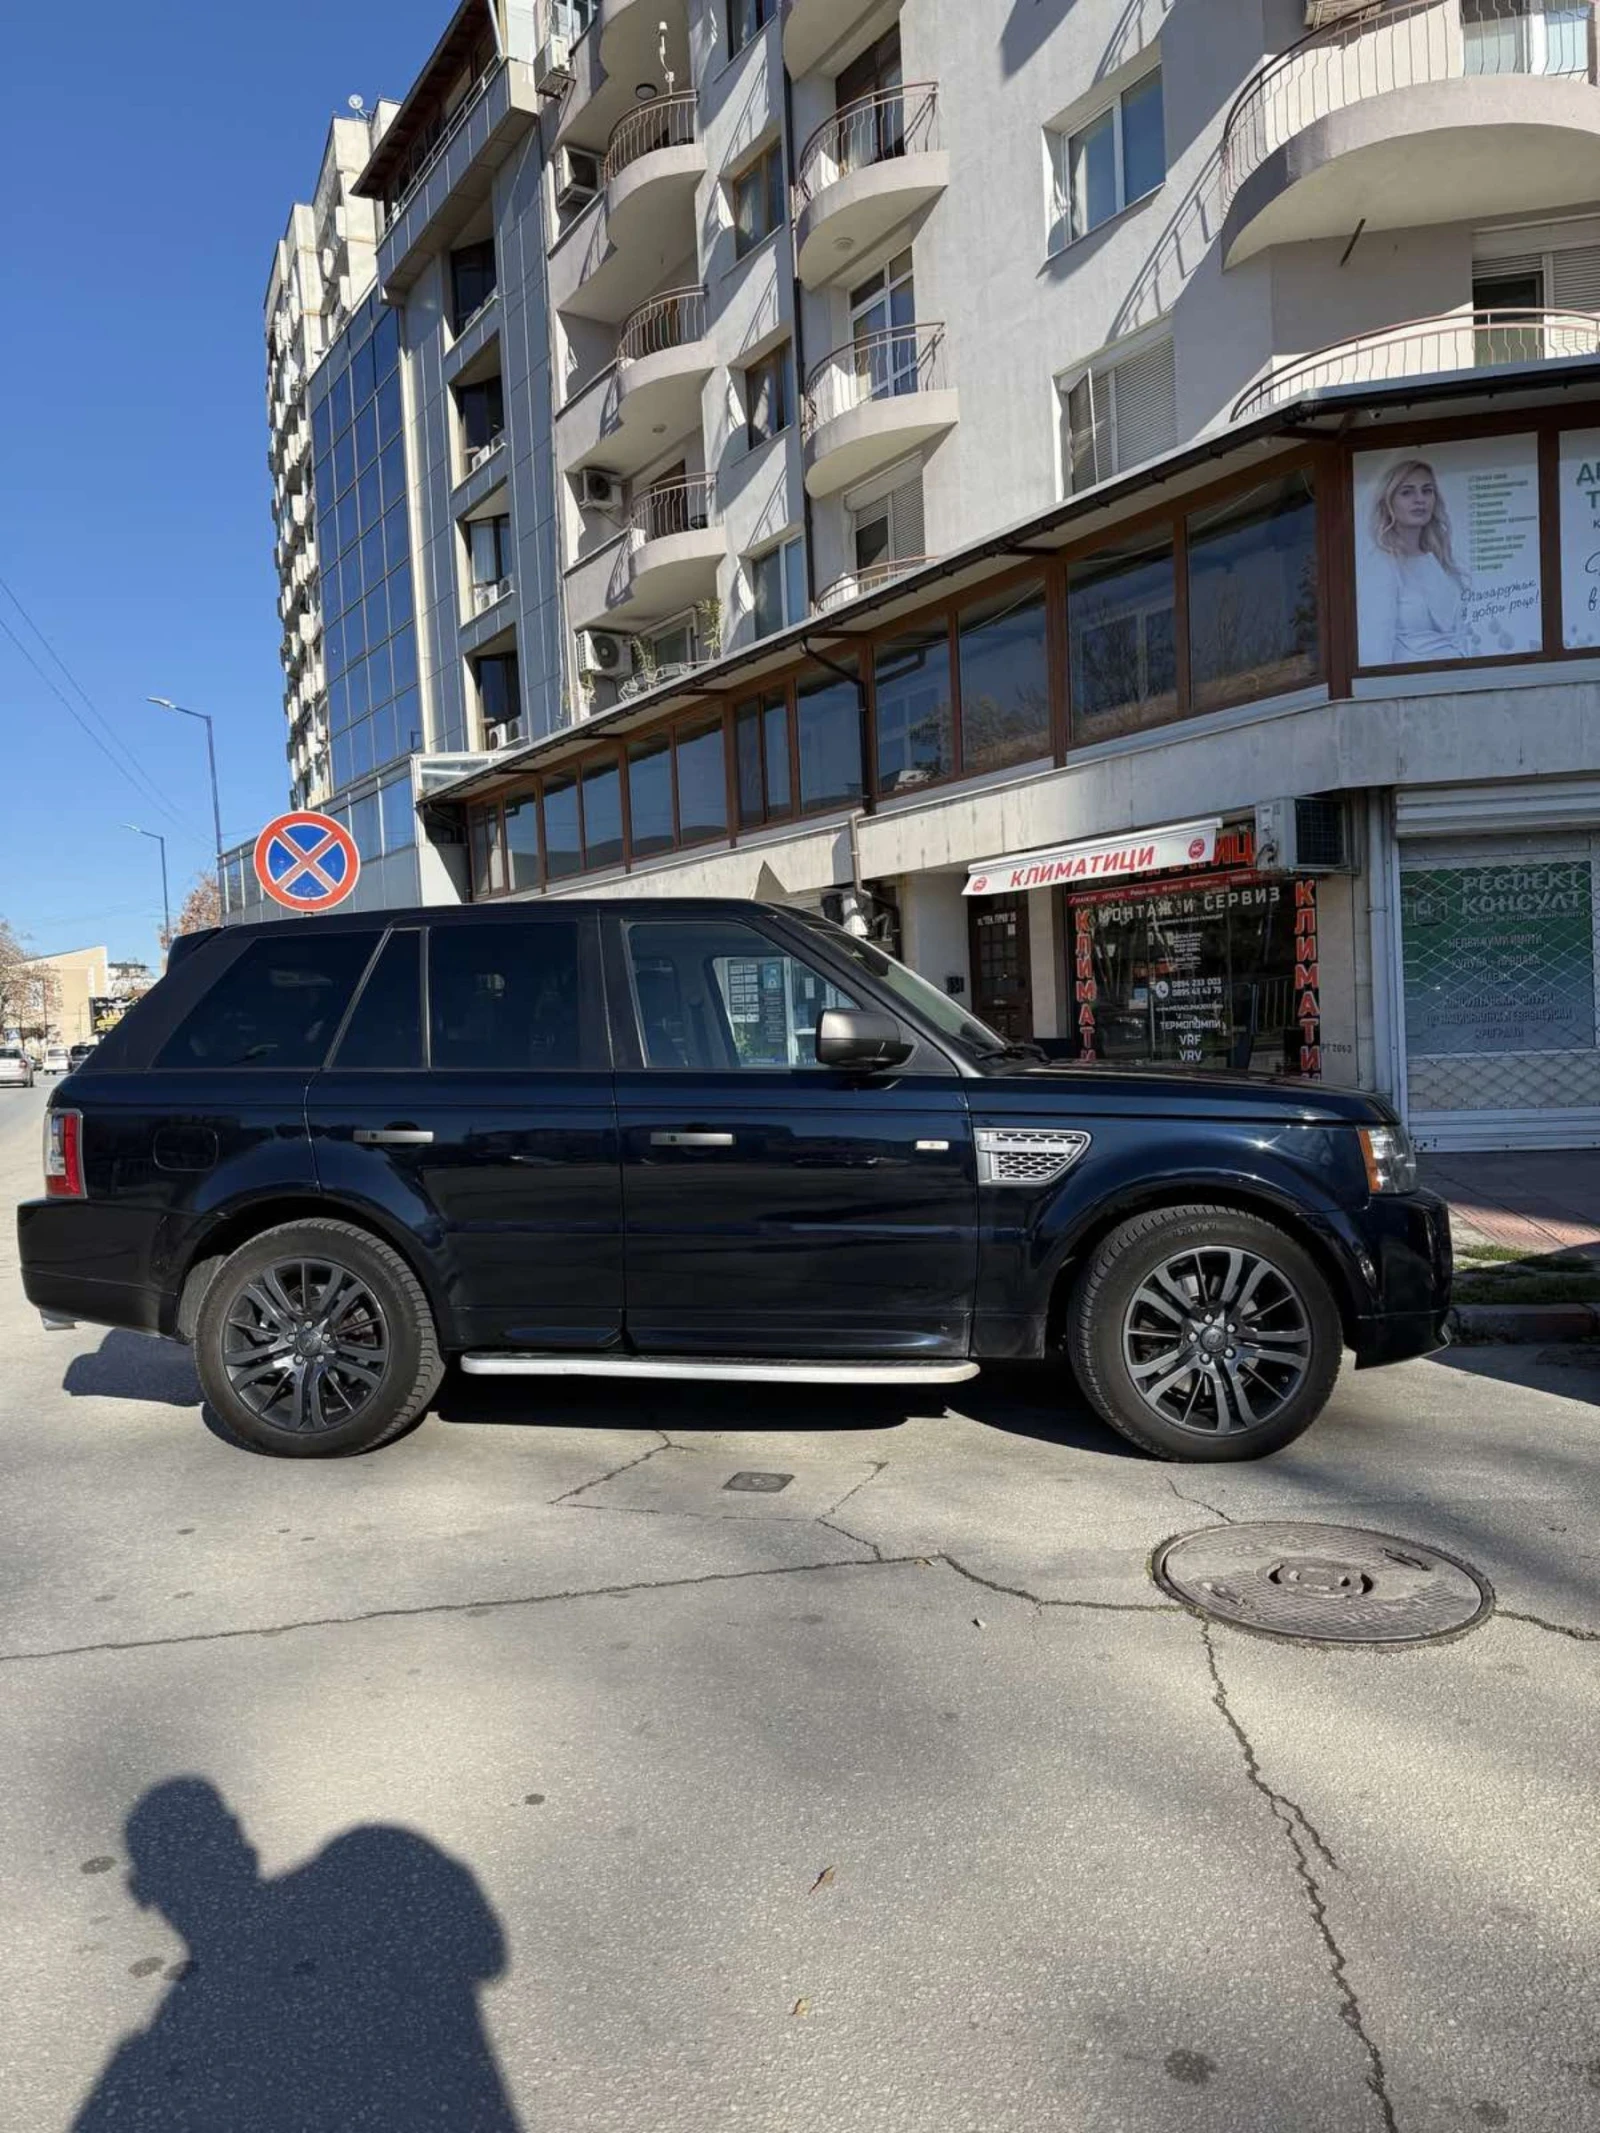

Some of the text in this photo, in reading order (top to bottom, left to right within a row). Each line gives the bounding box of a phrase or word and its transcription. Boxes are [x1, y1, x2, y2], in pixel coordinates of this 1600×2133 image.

[1009, 846, 1155, 887] КЛИМАТИЦИ
[1461, 870, 1579, 894] РЕСПЕКТ
[1099, 901, 1172, 921] МОНТАЖ
[1184, 899, 1194, 913] И
[1204, 887, 1280, 911] СЕРВИЗ
[1460, 890, 1579, 915] КОНСУЛТ
[1160, 1020, 1221, 1030] ТЕРМОПОМПИ
[1179, 1033, 1201, 1046] VRF
[1179, 1050, 1202, 1061] VRV
